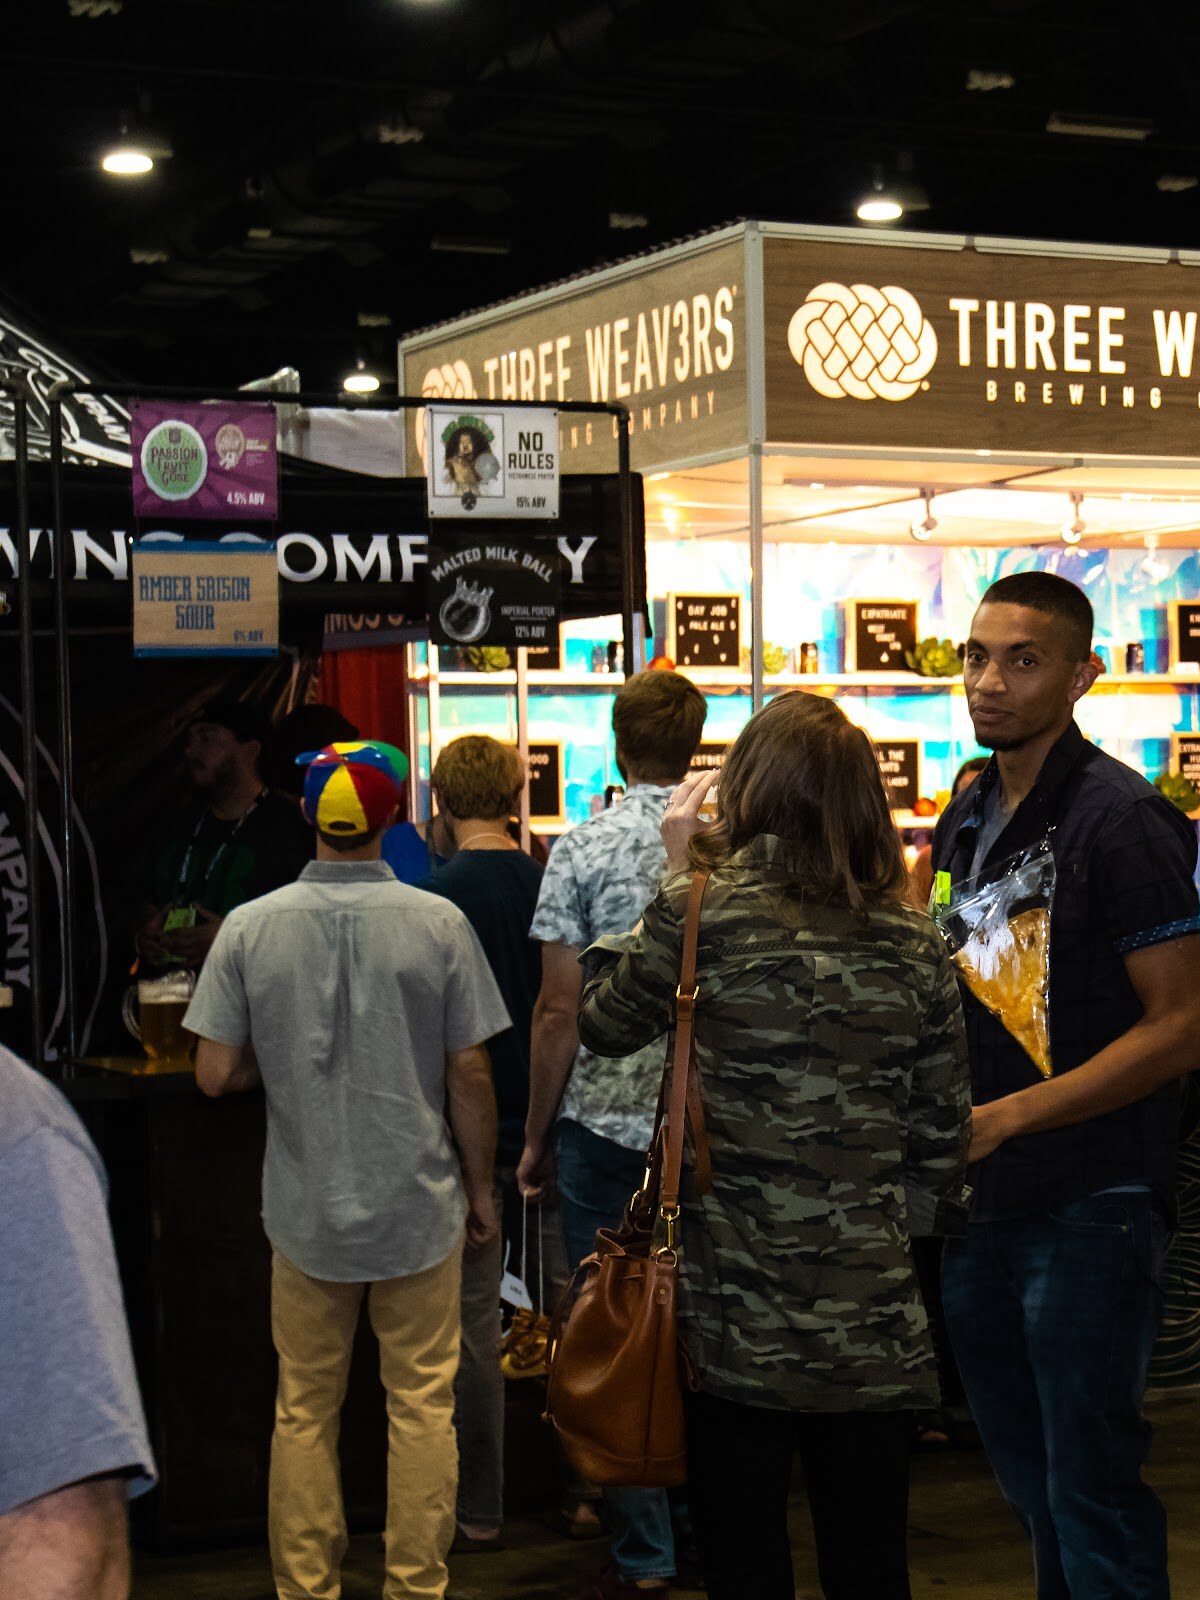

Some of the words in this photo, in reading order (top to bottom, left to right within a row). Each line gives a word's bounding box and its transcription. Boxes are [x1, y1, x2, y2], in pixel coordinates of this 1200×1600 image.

[585, 286, 735, 402] WEAV3RS
[949, 298, 1126, 374] THREE
[986, 380, 1161, 409] BREWING
[518, 431, 544, 452] NO
[150, 447, 198, 464] PASSION
[508, 453, 554, 470] RULES
[248, 491, 265, 506] ABV
[516, 496, 531, 508] 15%
[531, 496, 546, 508] ABV
[431, 547, 481, 582] MALTED
[485, 546, 520, 563] MILK
[521, 553, 553, 583] BALL
[139, 575, 192, 602] AMBER
[196, 576, 251, 602] SAISON
[175, 604, 216, 631] SOUR
[501, 606, 529, 616] IMPERIAL
[531, 606, 556, 617] PORTER
[687, 604, 705, 616] DAY
[710, 604, 728, 617] JOB
[861, 608, 907, 620] EXPATRIATE
[515, 626, 530, 638] 12%
[530, 626, 546, 638] ABV
[689, 620, 708, 631] PALE
[710, 620, 725, 631] ALE
